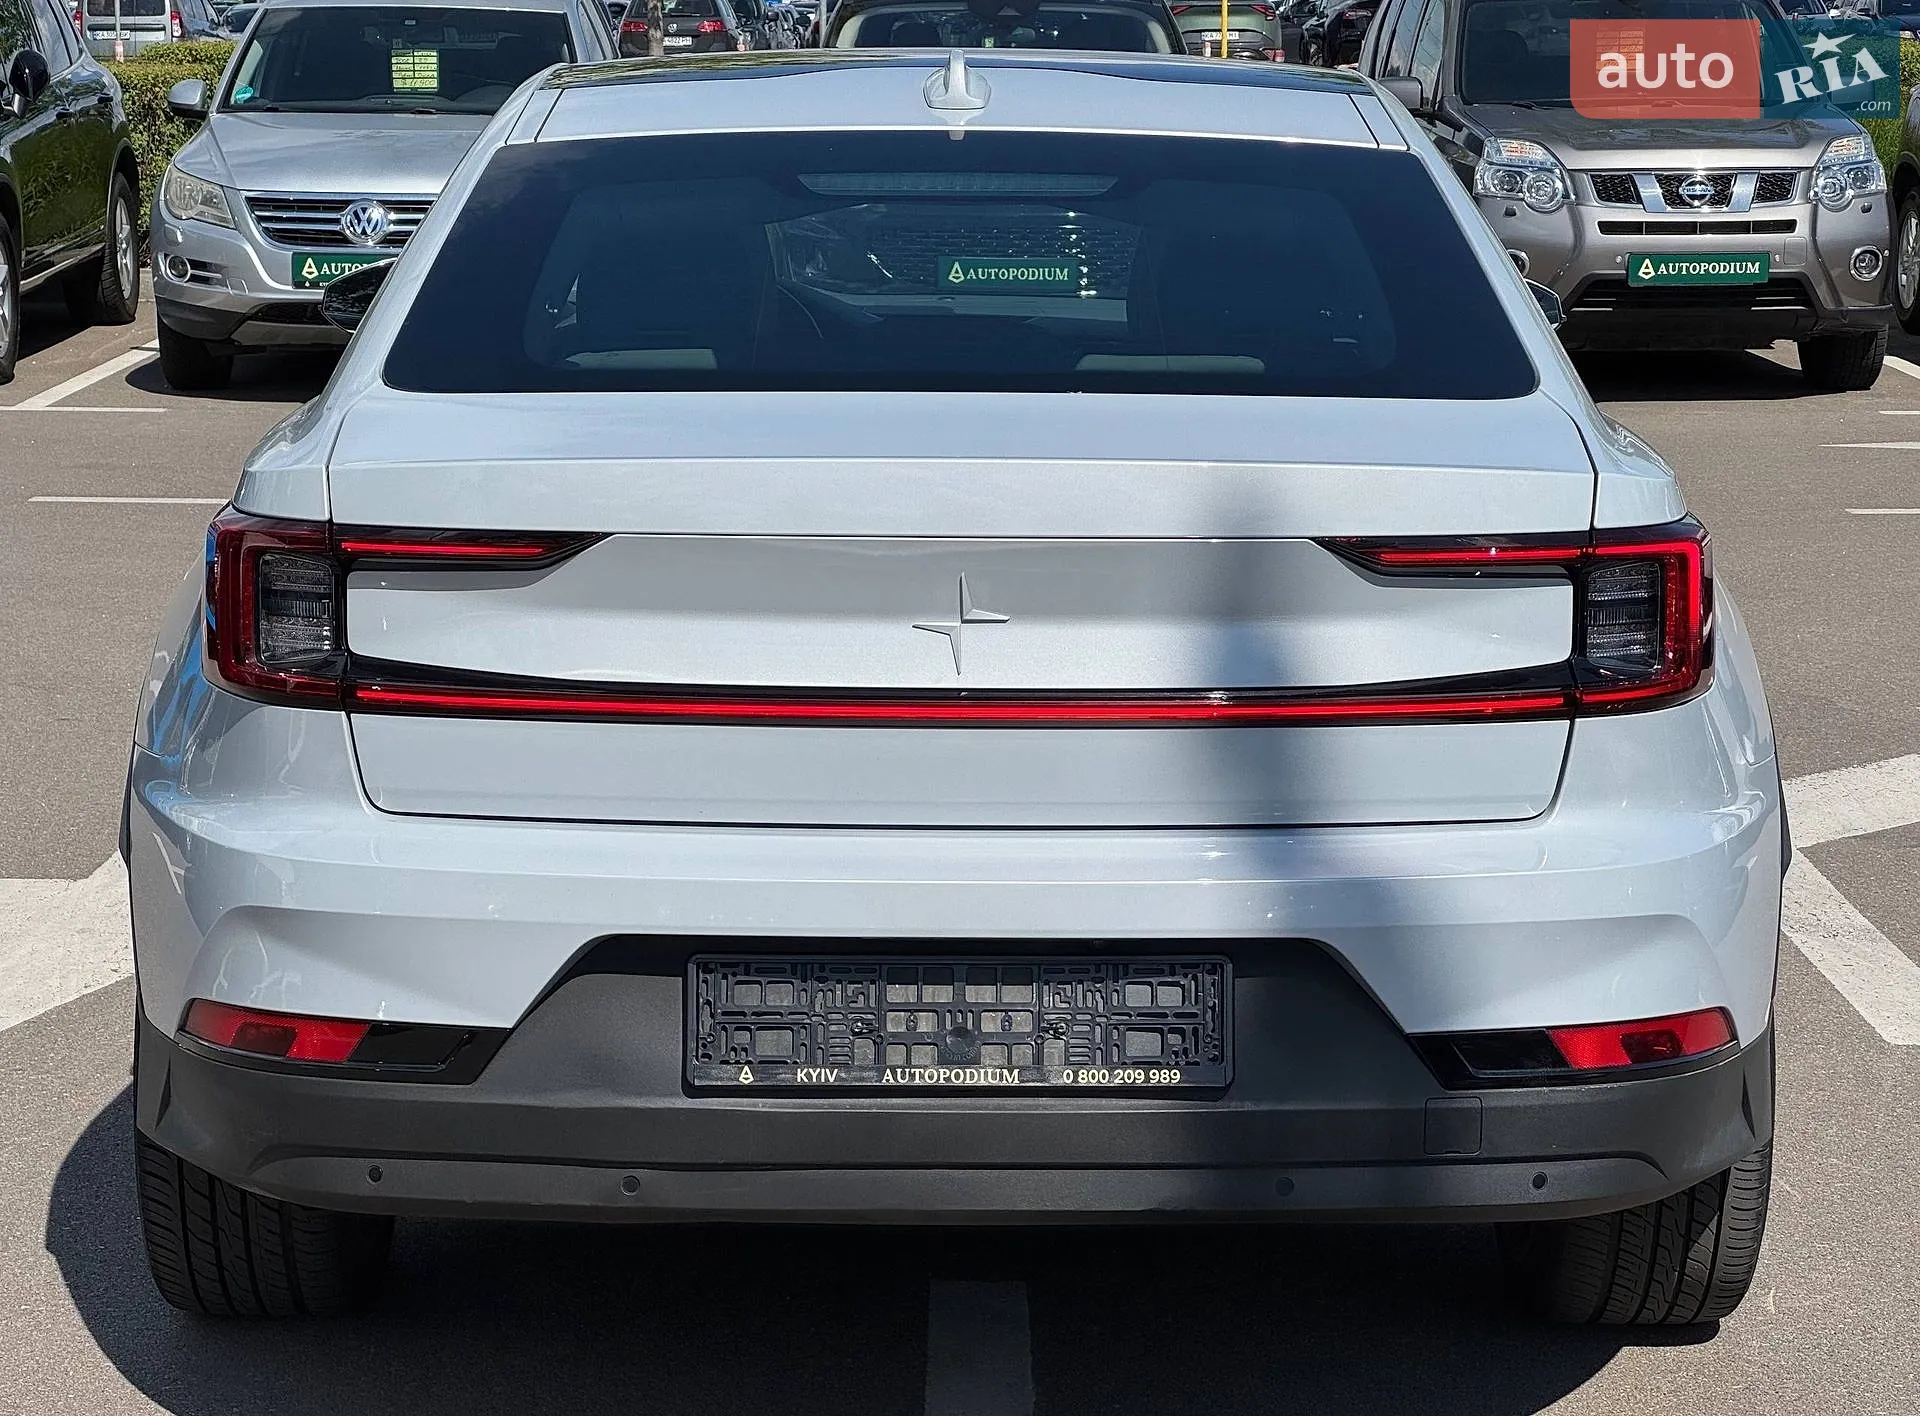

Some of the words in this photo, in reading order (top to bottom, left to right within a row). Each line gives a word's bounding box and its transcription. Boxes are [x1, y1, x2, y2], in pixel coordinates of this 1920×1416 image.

[966, 267, 1069, 281] AUTOPODIUM
[1657, 261, 1760, 275] AUTOPODIUM
[796, 1067, 839, 1083] KYIV
[881, 1067, 1021, 1084] AUTOPODIUM
[1062, 1069, 1074, 1084] 0
[1077, 1069, 1109, 1084] 800
[1113, 1069, 1145, 1084] 209
[1149, 1069, 1181, 1084] 989
